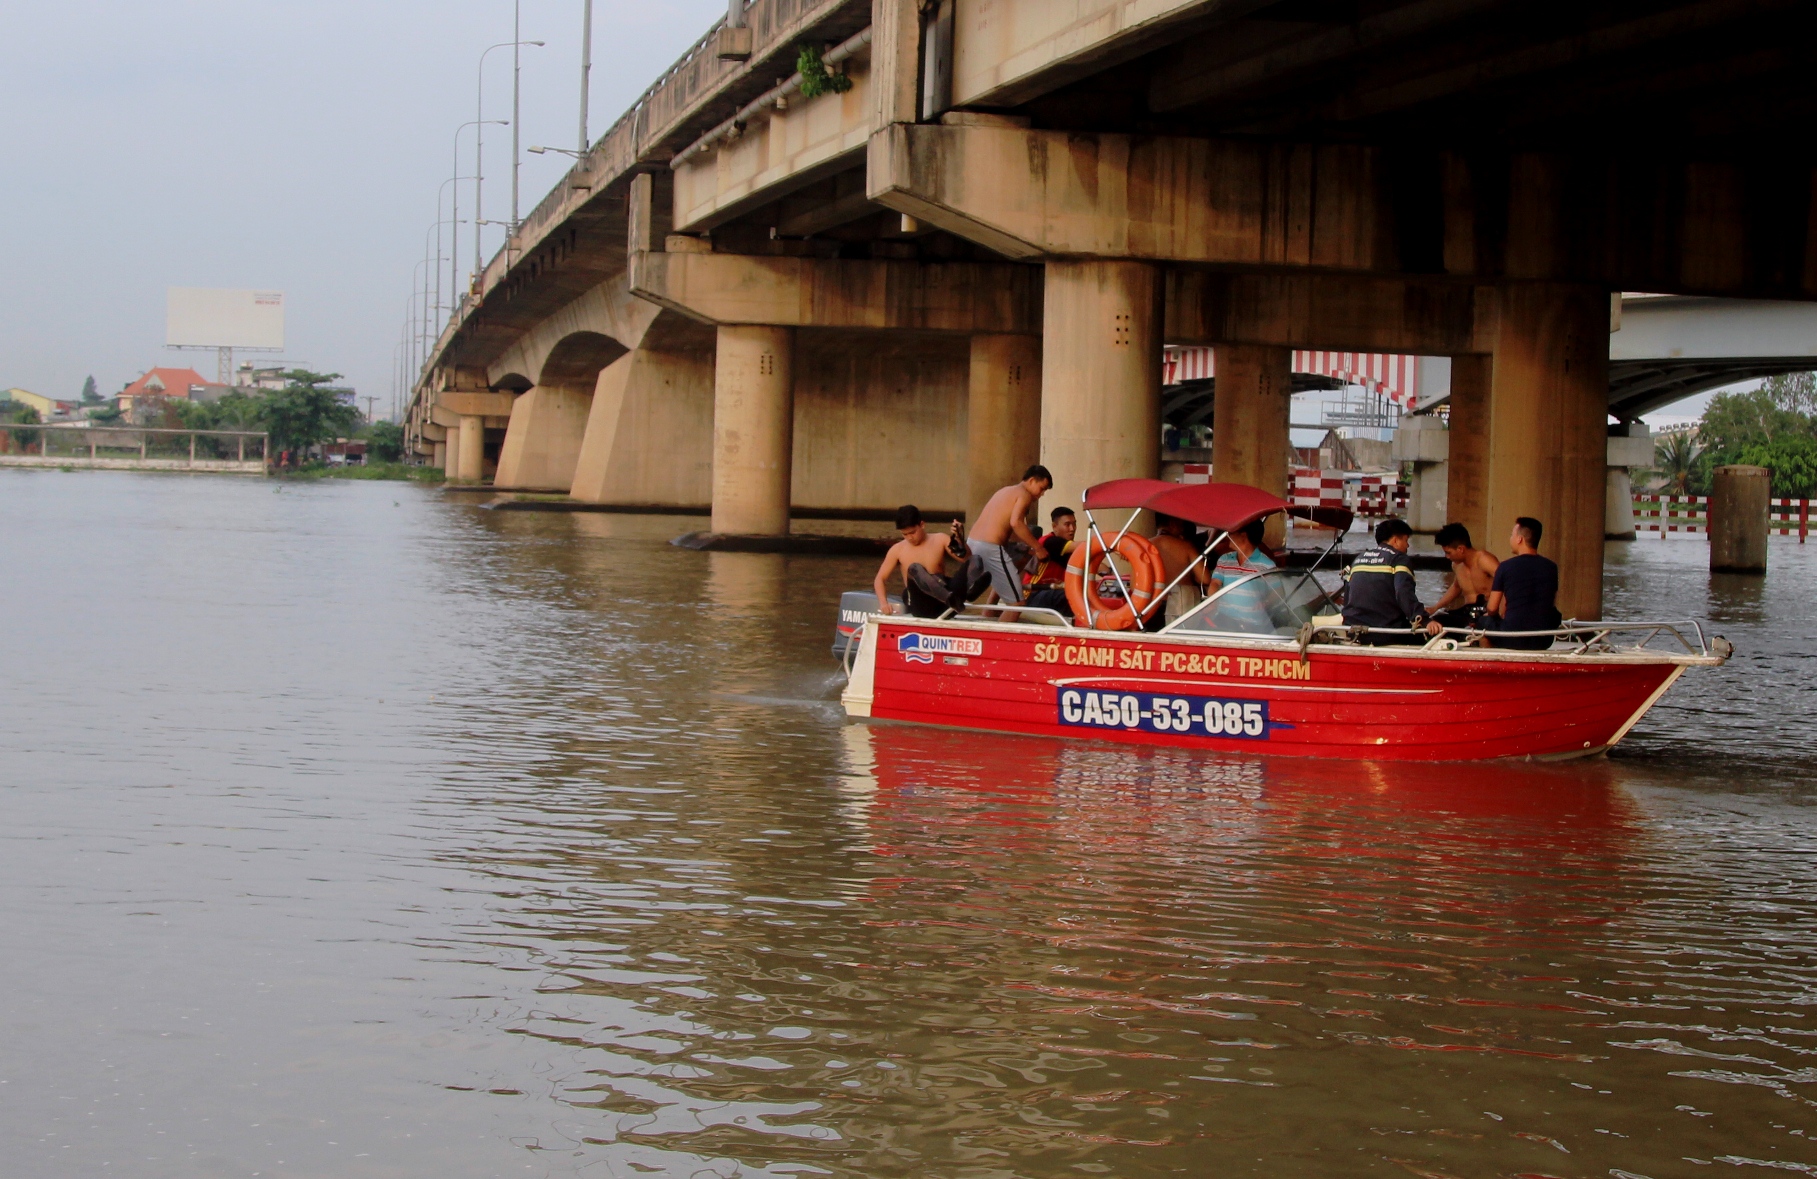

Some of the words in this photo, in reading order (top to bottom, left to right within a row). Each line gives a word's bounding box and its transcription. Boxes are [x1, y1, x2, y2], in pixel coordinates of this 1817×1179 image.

[842, 609, 881, 624] YAMA
[922, 636, 980, 653] QUINTREX
[1033, 637, 1060, 663] SỞ
[1064, 638, 1114, 668] CẢNH
[1119, 644, 1155, 671] SÁT
[1160, 655, 1230, 676] PC&CC
[1236, 657, 1311, 681] TP.HCM
[1062, 690, 1264, 736] CA50-53-085
